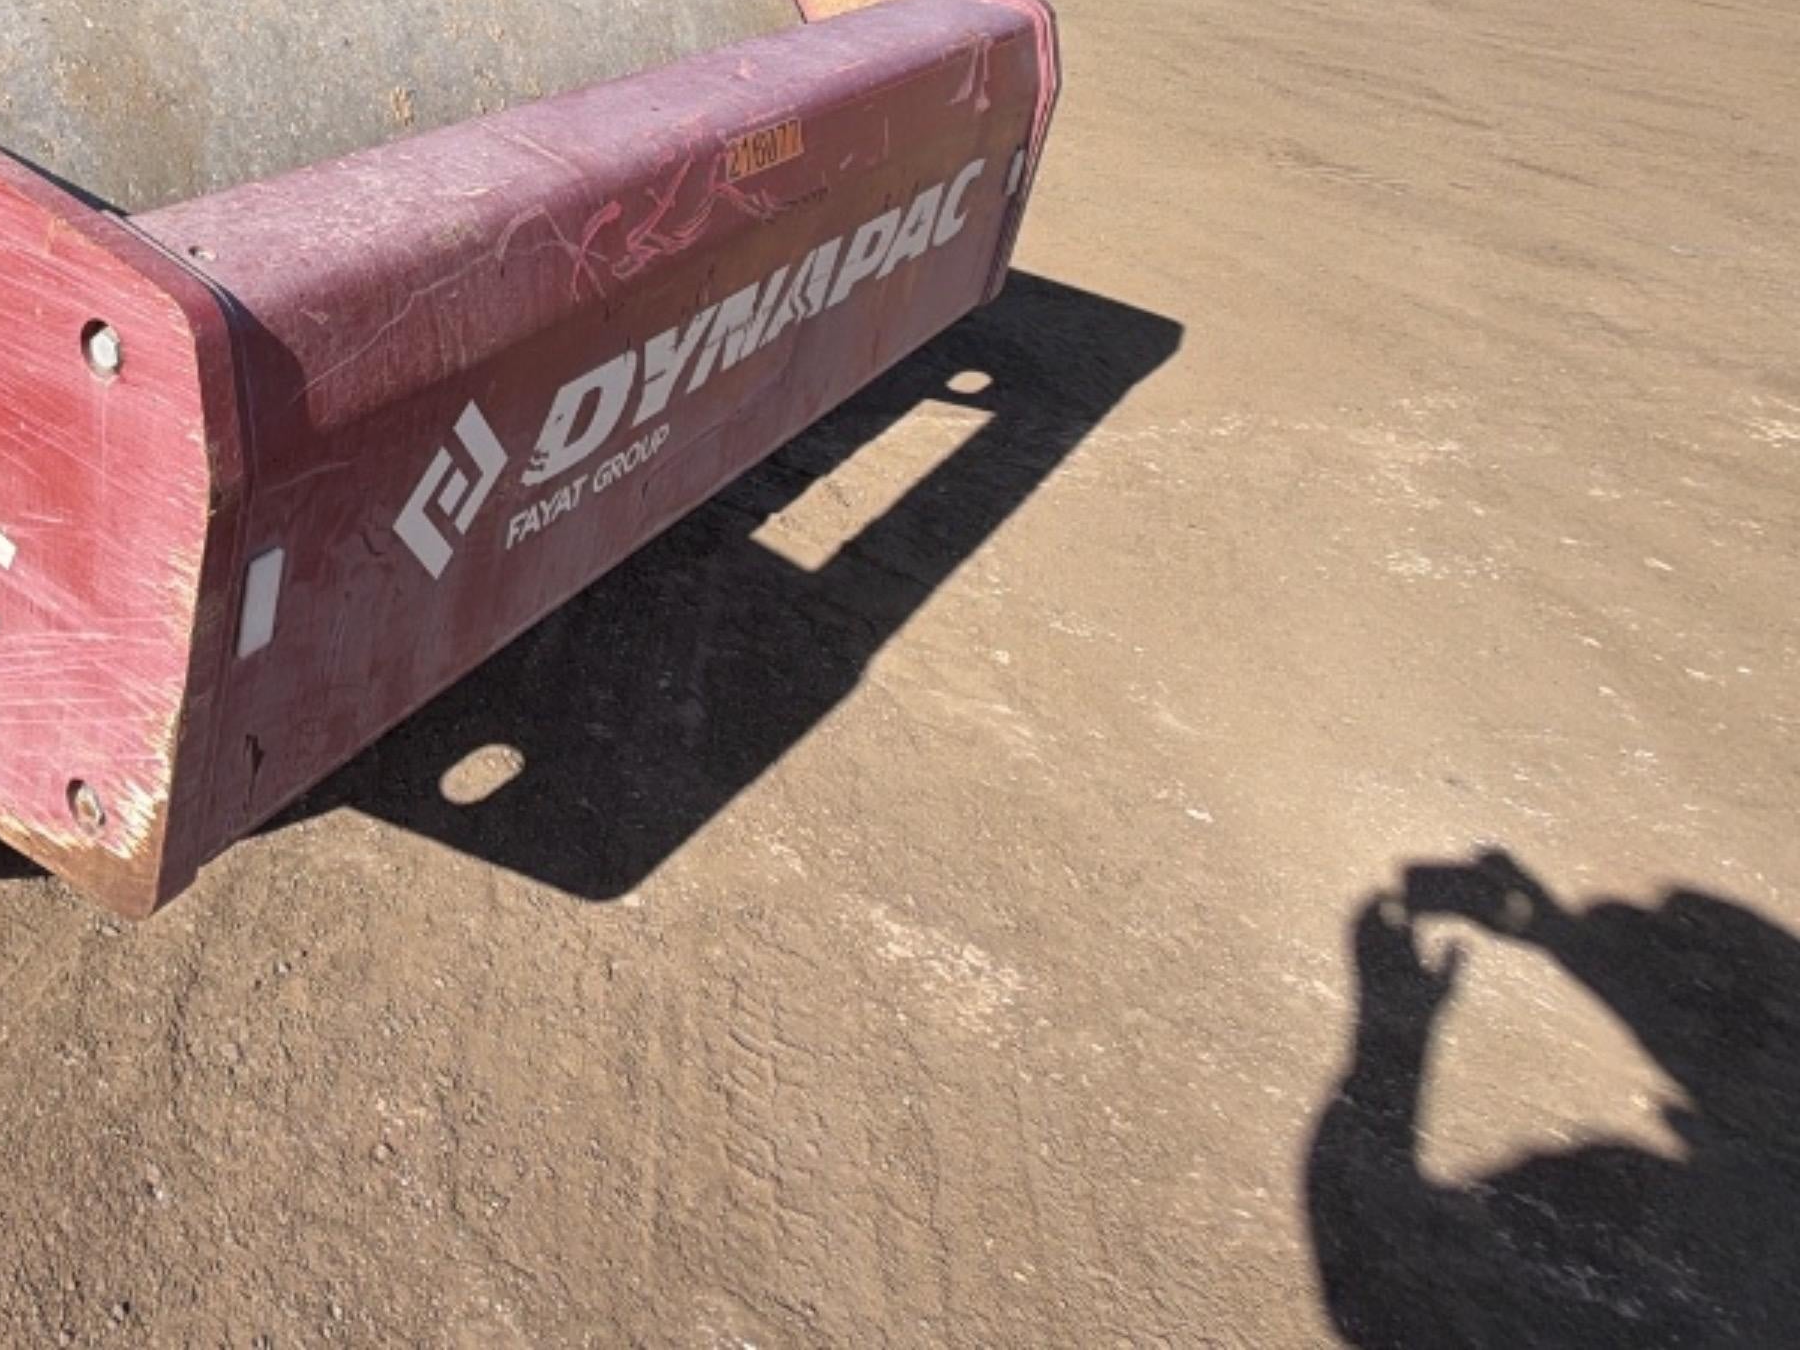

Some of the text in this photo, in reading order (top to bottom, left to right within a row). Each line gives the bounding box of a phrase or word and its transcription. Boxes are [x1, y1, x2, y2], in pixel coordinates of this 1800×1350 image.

[727, 118, 800, 180] 218077
[521, 158, 985, 487] DYNAPAC
[506, 422, 671, 550] FAYAT GROUP
